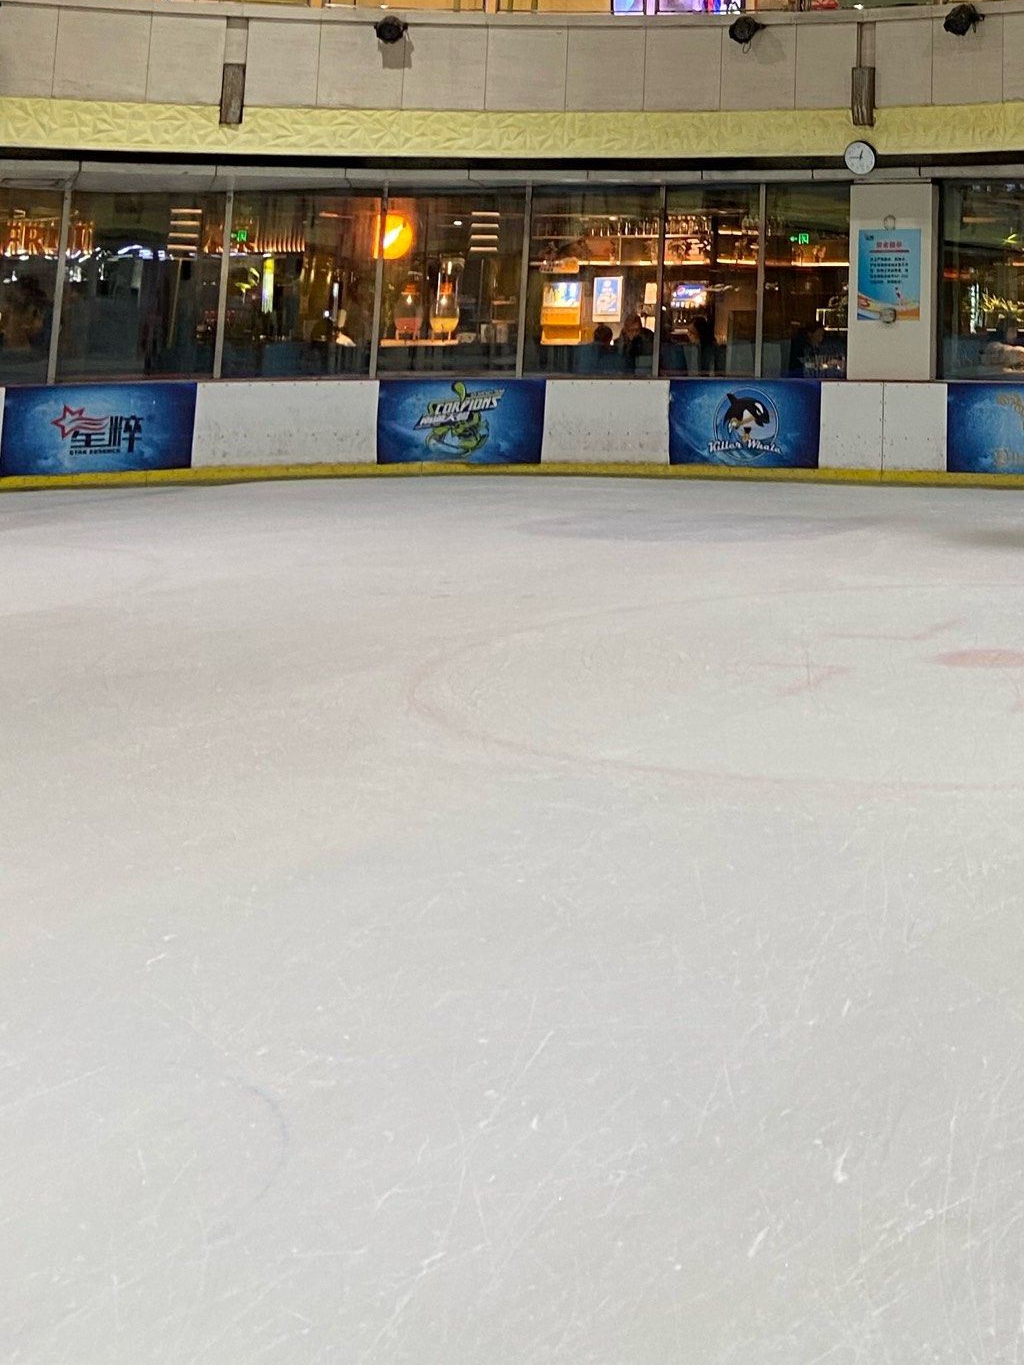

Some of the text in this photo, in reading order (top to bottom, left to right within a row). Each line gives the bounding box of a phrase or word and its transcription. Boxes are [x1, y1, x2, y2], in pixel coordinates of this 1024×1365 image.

[427, 395, 499, 415] SCORPIONS
[708, 438, 781, 455] Killer Whale
